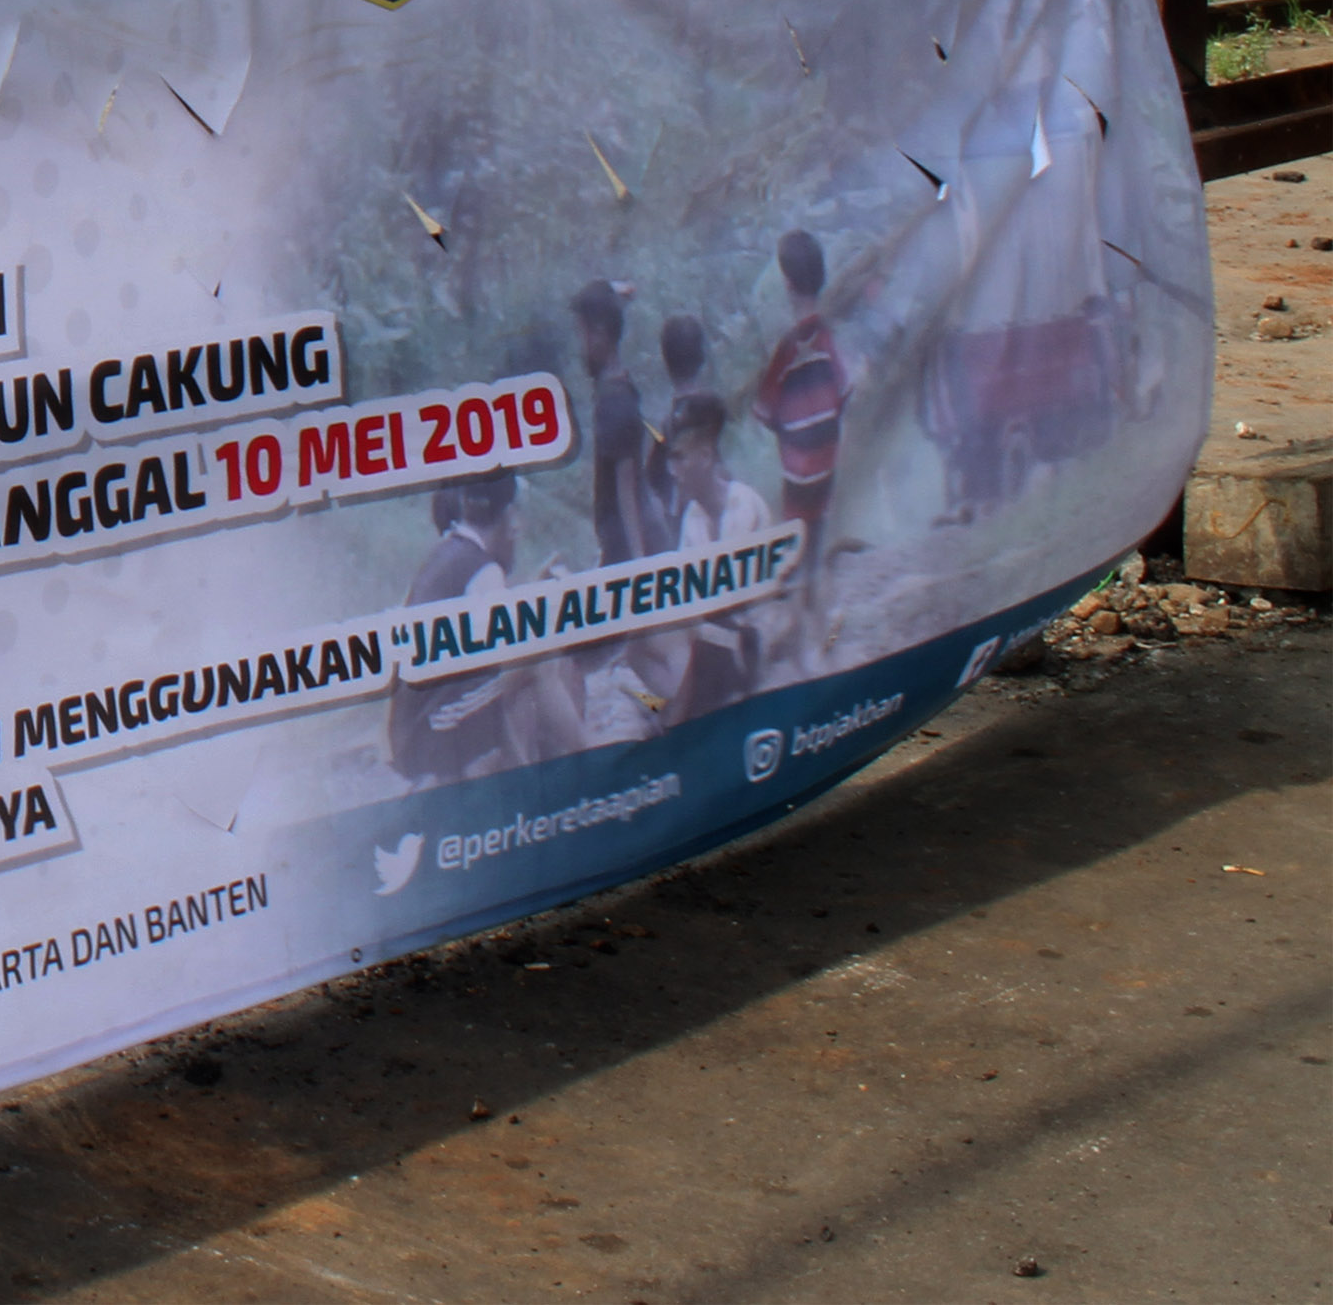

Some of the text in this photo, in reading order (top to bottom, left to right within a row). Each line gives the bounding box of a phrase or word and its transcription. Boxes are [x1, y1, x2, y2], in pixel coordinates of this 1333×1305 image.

[89, 325, 331, 425] CAKUNG
[215, 434, 283, 502] 10
[298, 411, 408, 488] MEI
[418, 387, 559, 465] 2019
[14, 630, 386, 758] MENGGUNAKAN
[436, 771, 682, 870] @perkeretaapian
[71, 914, 138, 967] DAN
[145, 874, 268, 944] BANTEN
